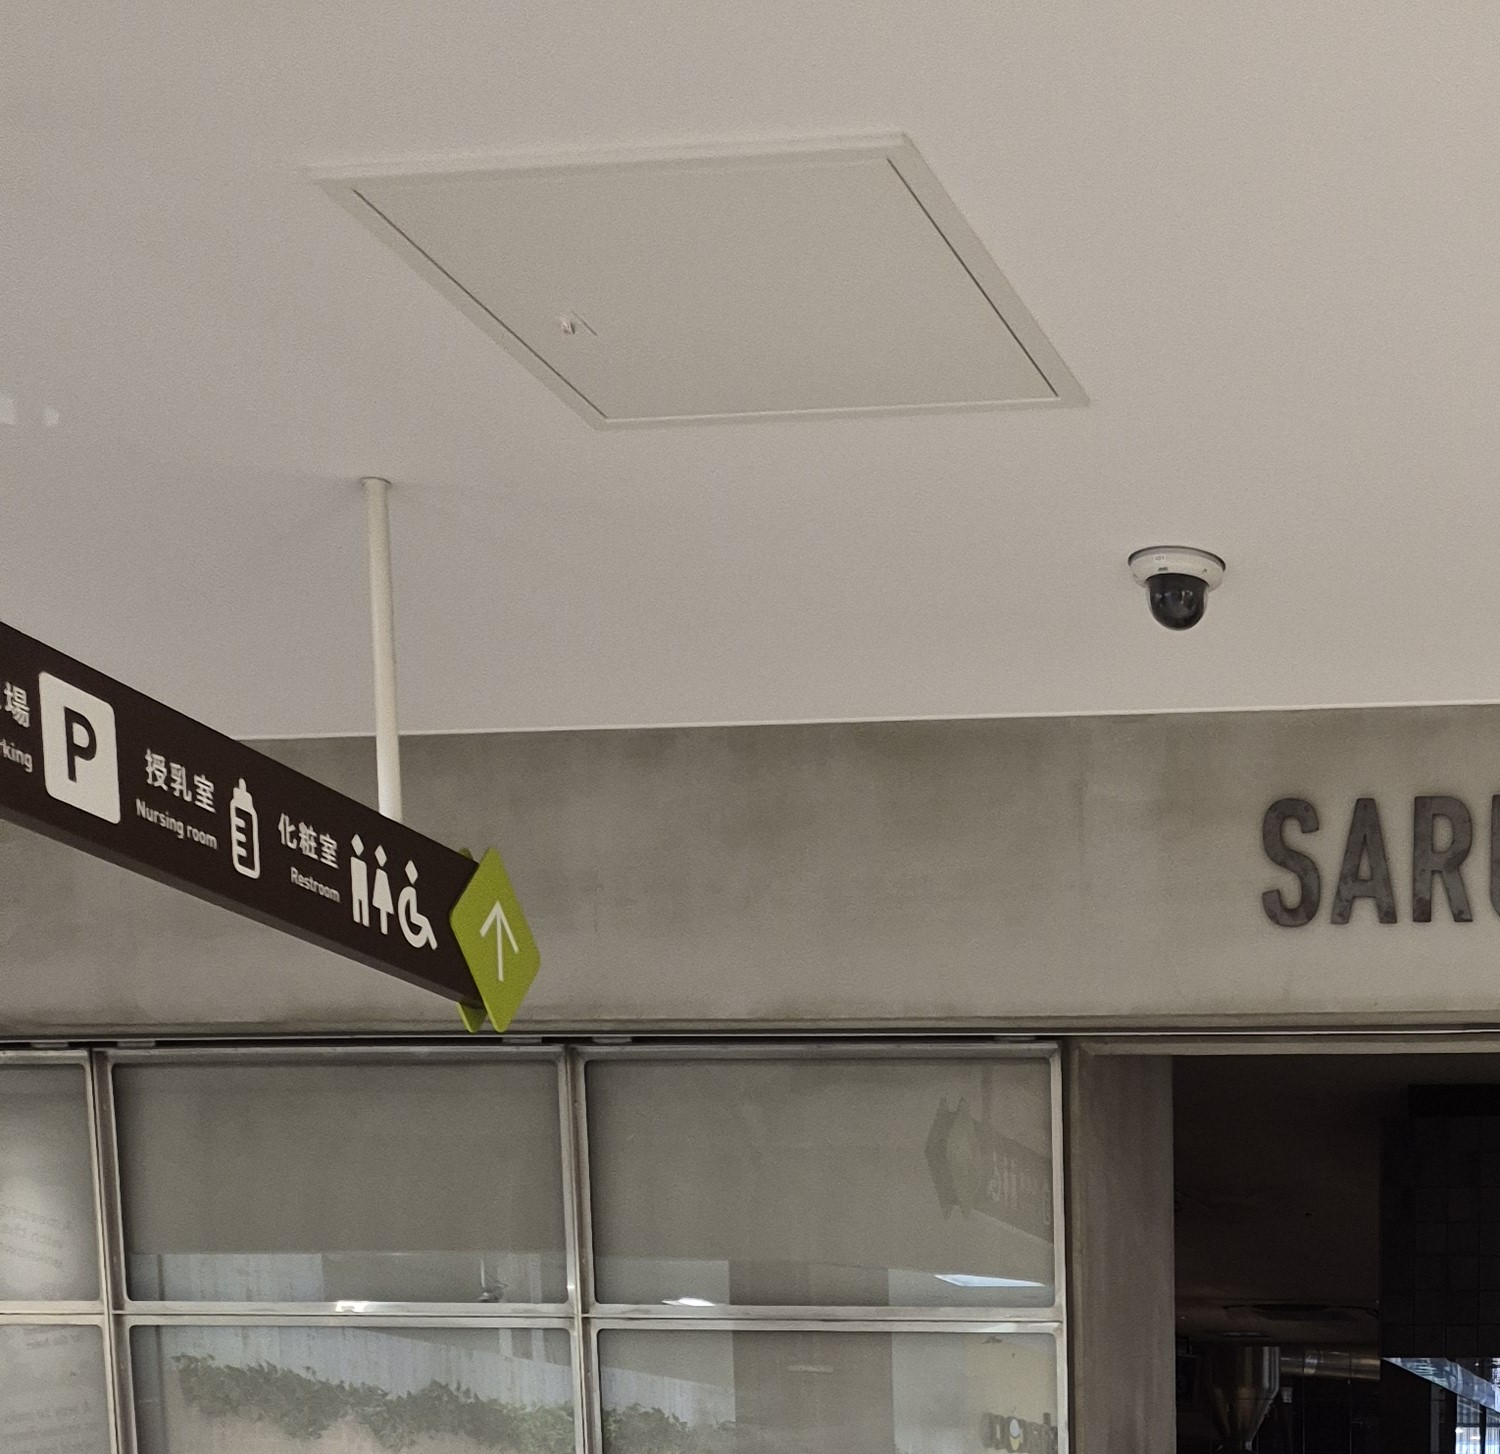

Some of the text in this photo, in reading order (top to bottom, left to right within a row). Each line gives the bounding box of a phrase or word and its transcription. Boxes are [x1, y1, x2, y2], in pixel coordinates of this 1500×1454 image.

[0, 682, 30, 727] 場
[0, 739, 33, 773] king
[64, 706, 97, 783] P
[145, 748, 216, 813] 授乳室
[136, 798, 218, 850] Nursing room
[278, 812, 339, 869] 化粧室
[290, 866, 341, 903] Restroom
